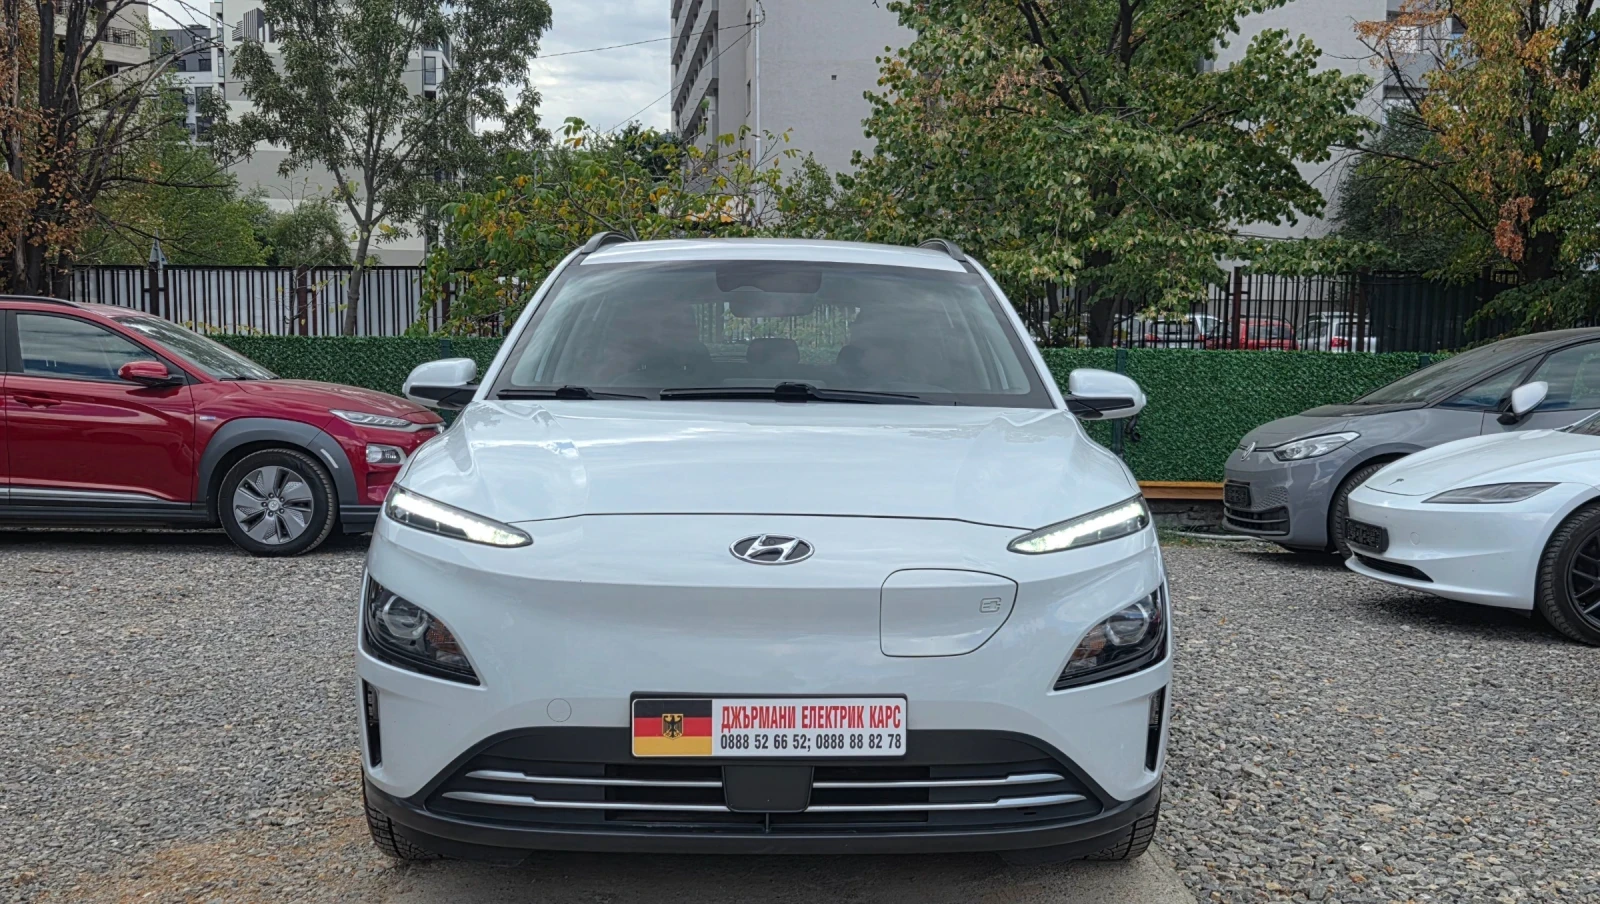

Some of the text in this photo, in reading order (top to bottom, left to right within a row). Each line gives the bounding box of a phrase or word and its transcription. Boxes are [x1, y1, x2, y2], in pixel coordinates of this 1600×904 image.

[721, 704, 901, 733] ДЖЪРМАНИ ЕЛЕКТРИК КАРС
[720, 733, 902, 752] 0888 52 66 52; 0888 88 82 78
